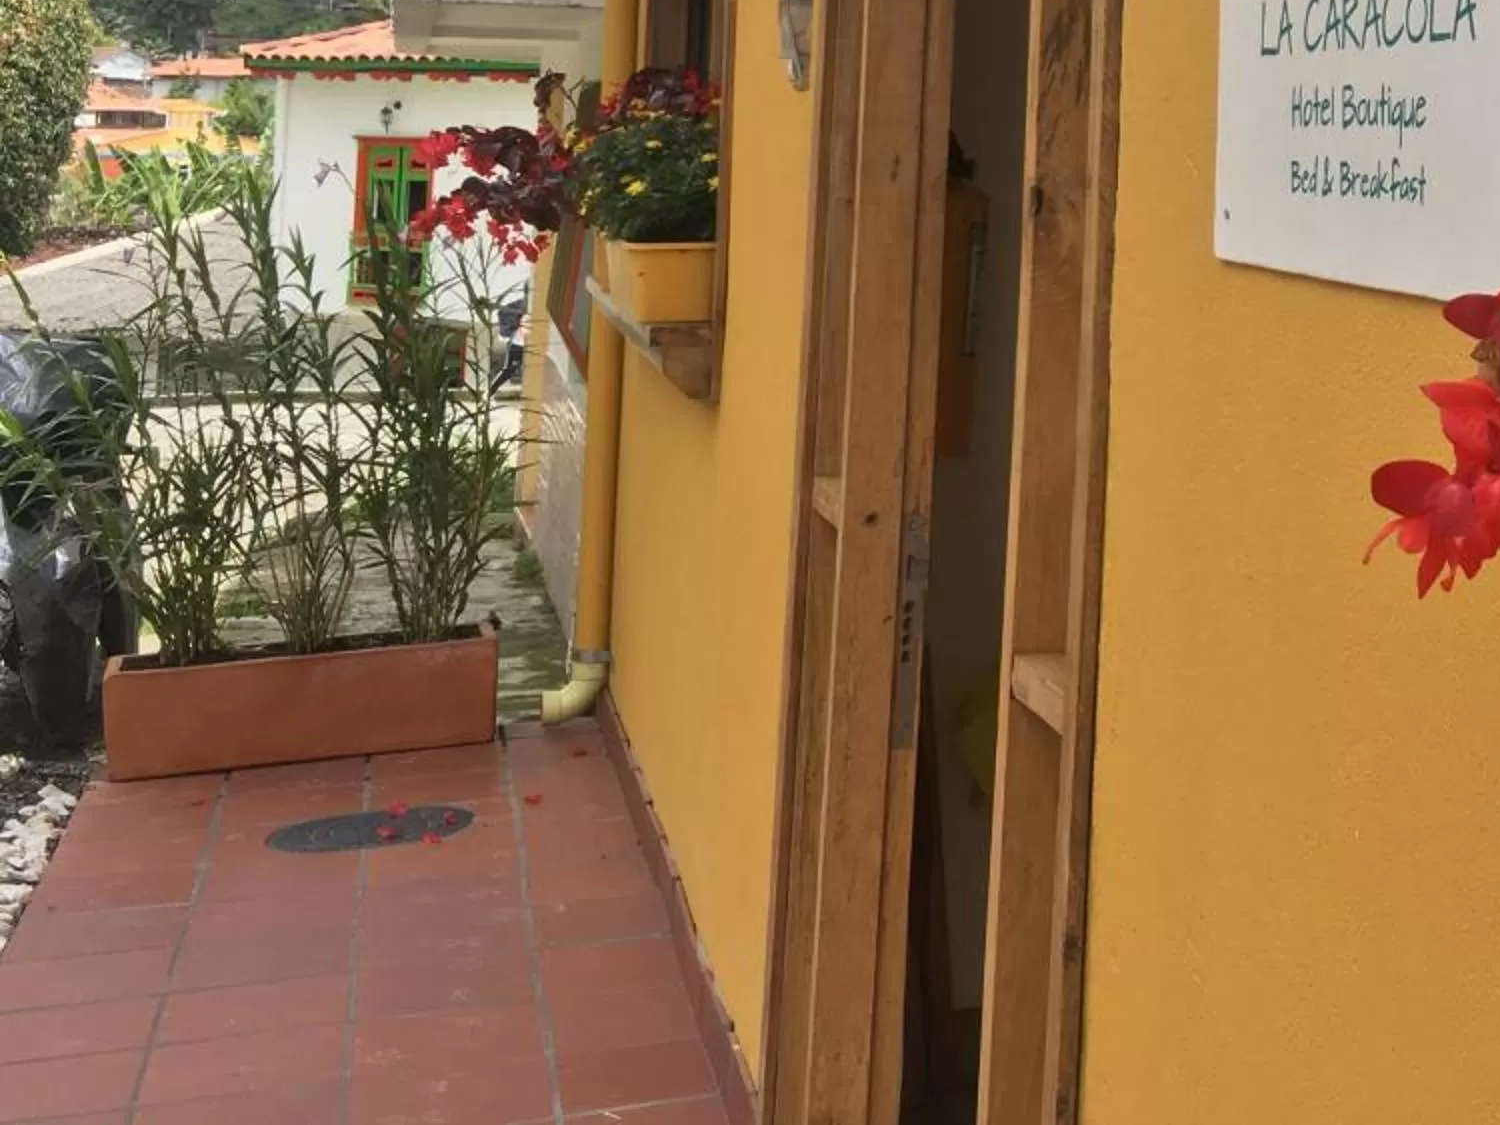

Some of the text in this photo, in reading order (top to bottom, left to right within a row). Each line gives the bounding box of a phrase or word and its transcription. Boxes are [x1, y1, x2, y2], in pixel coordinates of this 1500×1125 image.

[1291, 82, 1427, 149] Hotel Boutique
[1290, 155, 1427, 206] Bed & Breakfast
